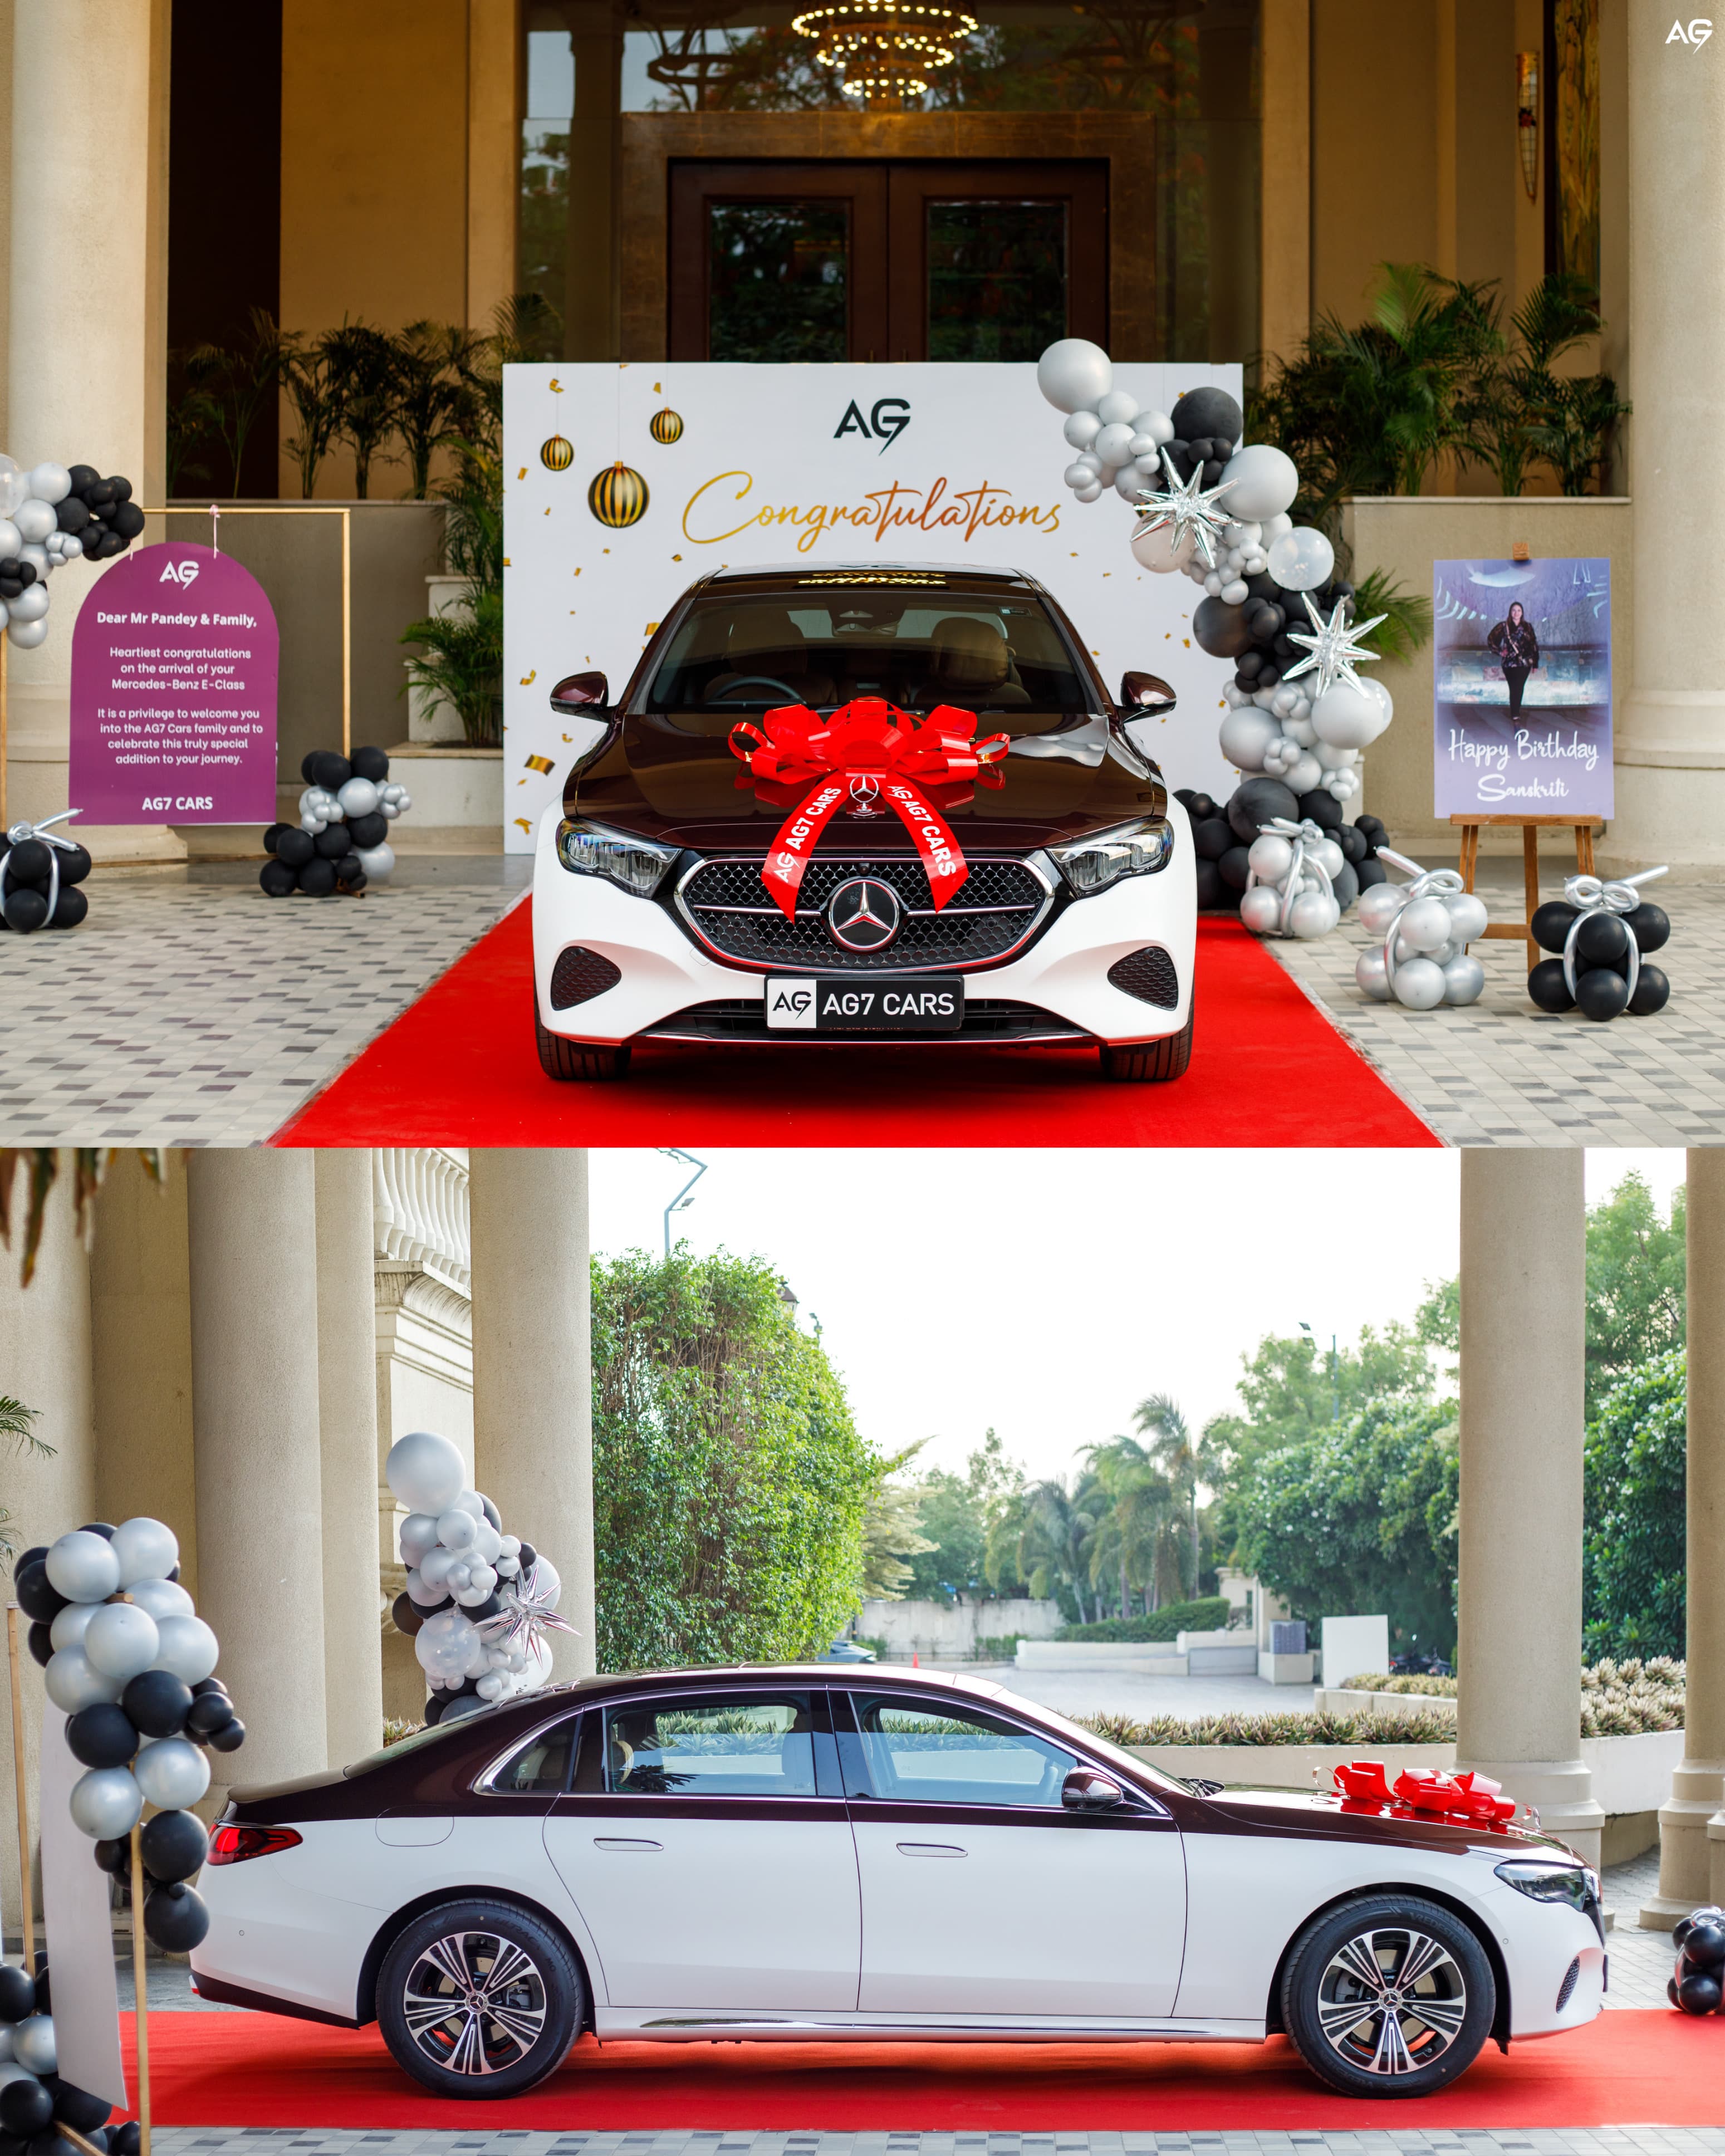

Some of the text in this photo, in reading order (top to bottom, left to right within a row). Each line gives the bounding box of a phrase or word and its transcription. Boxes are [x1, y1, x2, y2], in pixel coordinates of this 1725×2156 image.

[682, 470, 1061, 553] Congratulations
[97, 611, 257, 629] Dear Mr Pandey & Family,
[110, 647, 251, 660] Heartiest congratulations
[120, 663, 235, 676] on the arrival of your
[111, 678, 245, 690] Mercedes-Benz E-Class
[97, 708, 259, 721] It is a privilege to welcome you
[100, 723, 263, 736] into the AG7 Cars family and to
[107, 738, 248, 751] celebrate this truly special
[1448, 729, 1600, 771] Happy Birthday
[115, 753, 242, 766] addition to your journey.
[1476, 773, 1570, 802] Sanskriti
[141, 796, 213, 811] AG7 CARS
[785, 817, 814, 850] AG7
[805, 787, 841, 815] CARS
[901, 801, 933, 821] AG7
[922, 825, 956, 877] CARS
[822, 993, 875, 1015] AG7
[883, 993, 954, 1015] CARS
